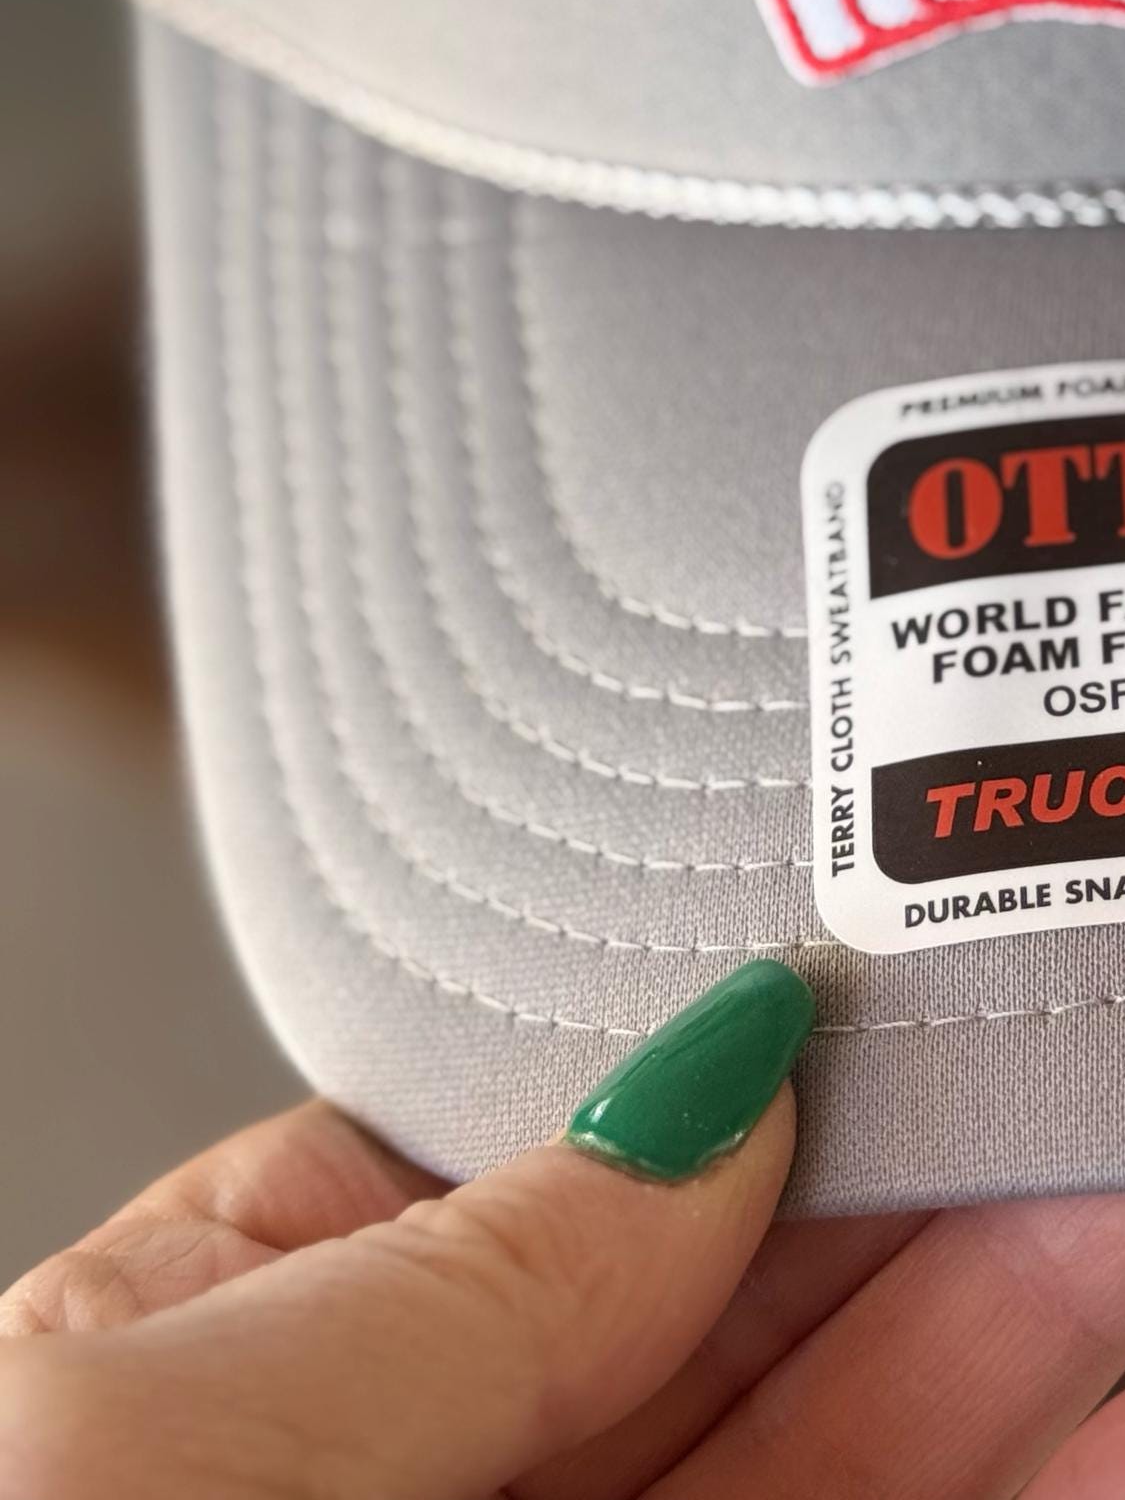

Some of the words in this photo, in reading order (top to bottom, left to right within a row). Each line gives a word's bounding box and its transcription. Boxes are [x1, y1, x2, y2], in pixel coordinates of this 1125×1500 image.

[900, 384, 1042, 417] PREMIUM
[824, 482, 852, 664] SWEATBAND
[891, 596, 1077, 650] WORLD
[932, 635, 1080, 684] FOAM
[830, 679, 854, 771] CLOTH
[831, 786, 855, 877] TERRY
[904, 883, 1053, 928] DURABLE
